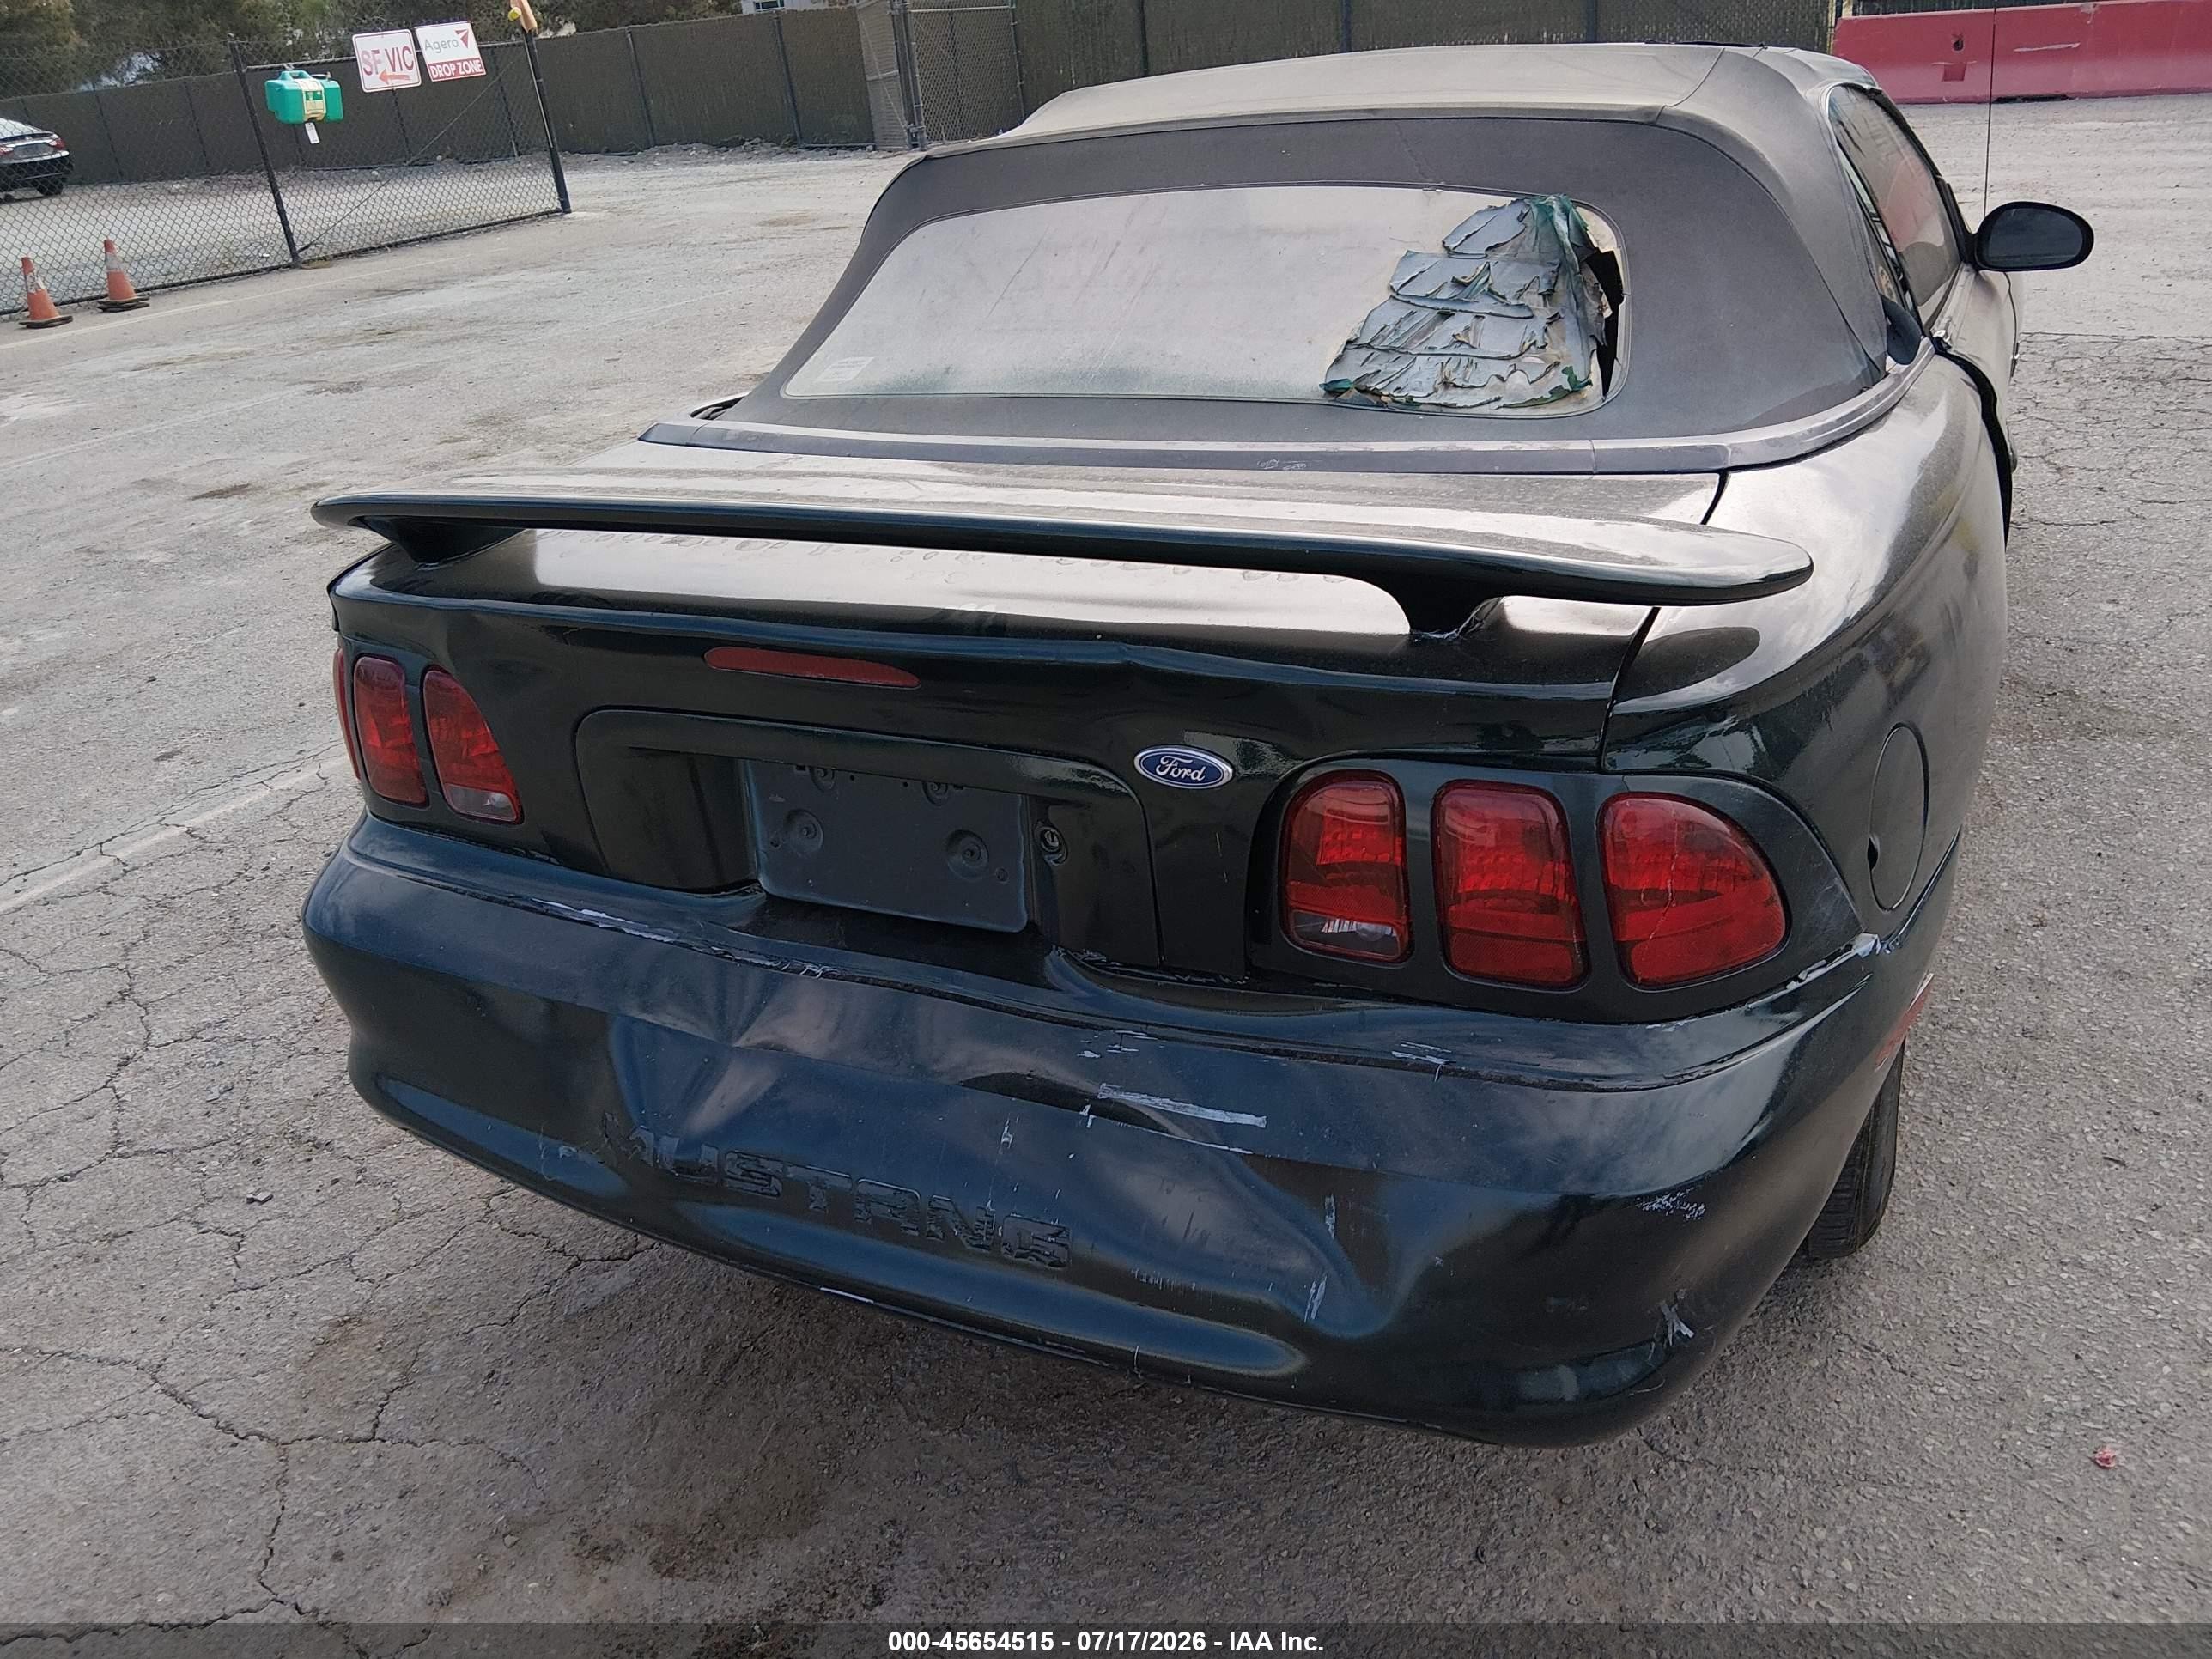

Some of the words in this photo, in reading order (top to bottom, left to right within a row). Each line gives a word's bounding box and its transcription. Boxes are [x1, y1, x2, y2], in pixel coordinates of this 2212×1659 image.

[424, 39, 459, 53] Agero
[429, 64, 456, 79] DROP
[457, 59, 483, 76] ZONE
[1155, 755, 1206, 781] Ford
